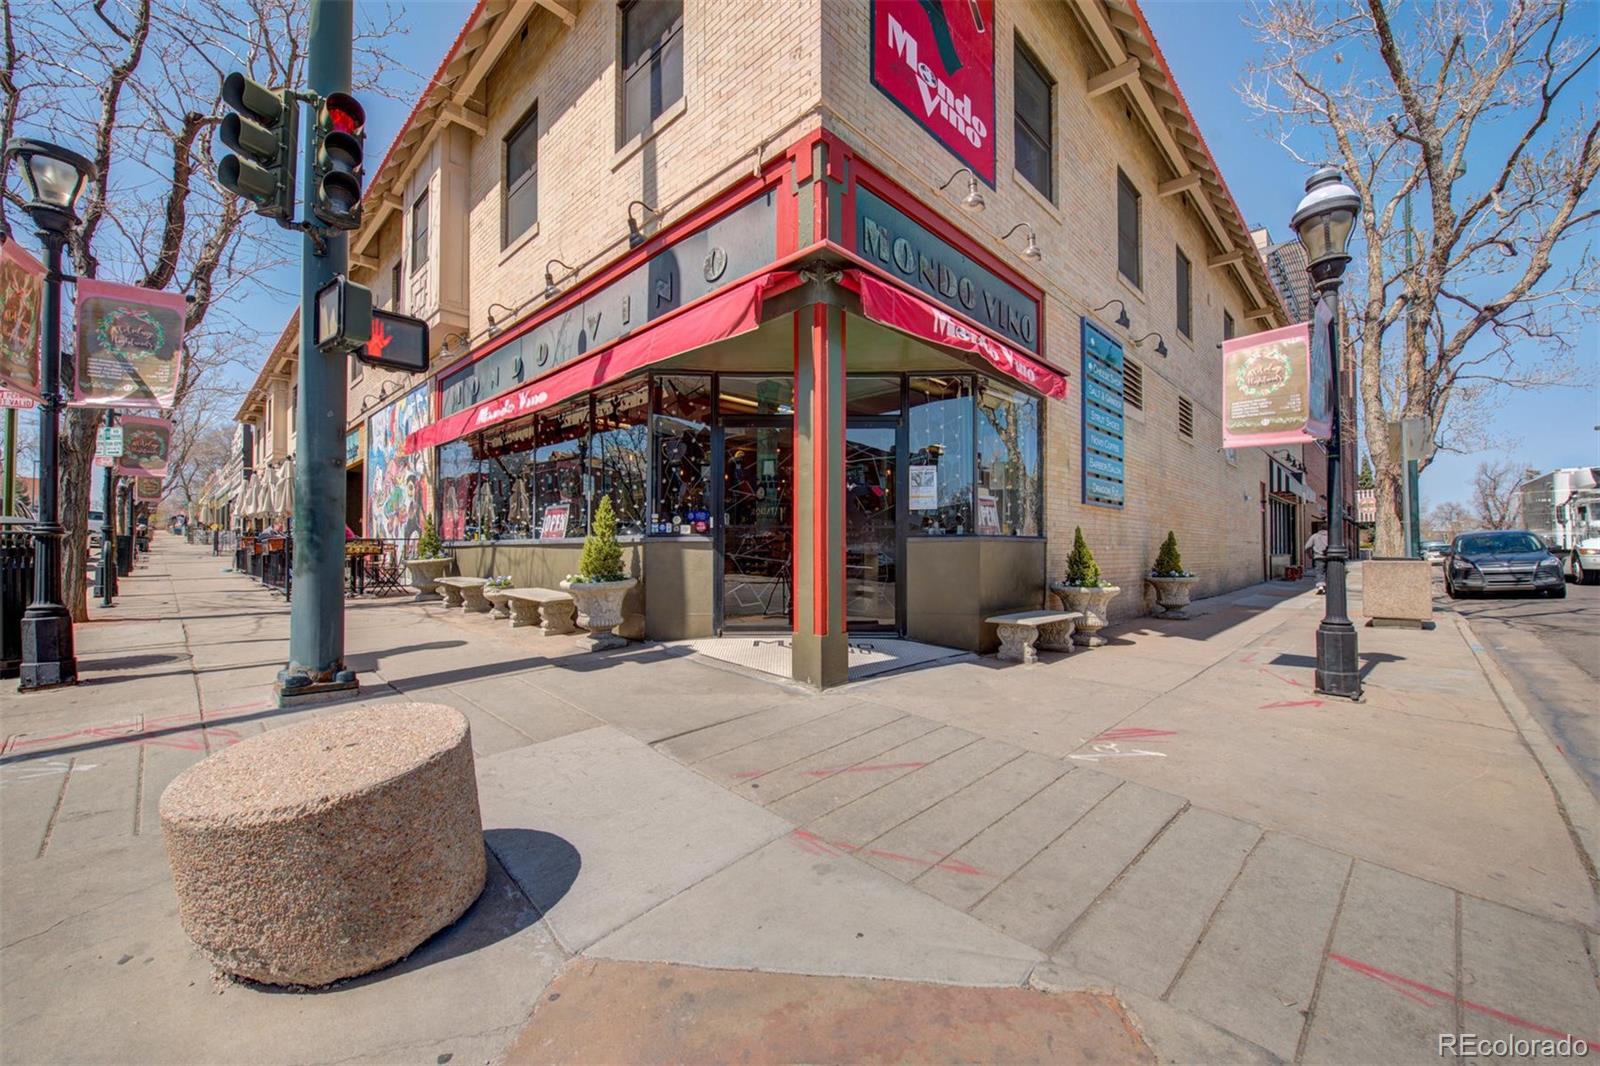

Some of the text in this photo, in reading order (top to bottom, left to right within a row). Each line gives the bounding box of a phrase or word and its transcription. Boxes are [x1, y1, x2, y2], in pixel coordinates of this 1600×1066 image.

[888, 13, 987, 138] Mondo
[915, 73, 981, 148] Vino
[587, 246, 728, 341] VINO
[864, 216, 1033, 344] MONDO VINO
[543, 513, 568, 532] OPEN
